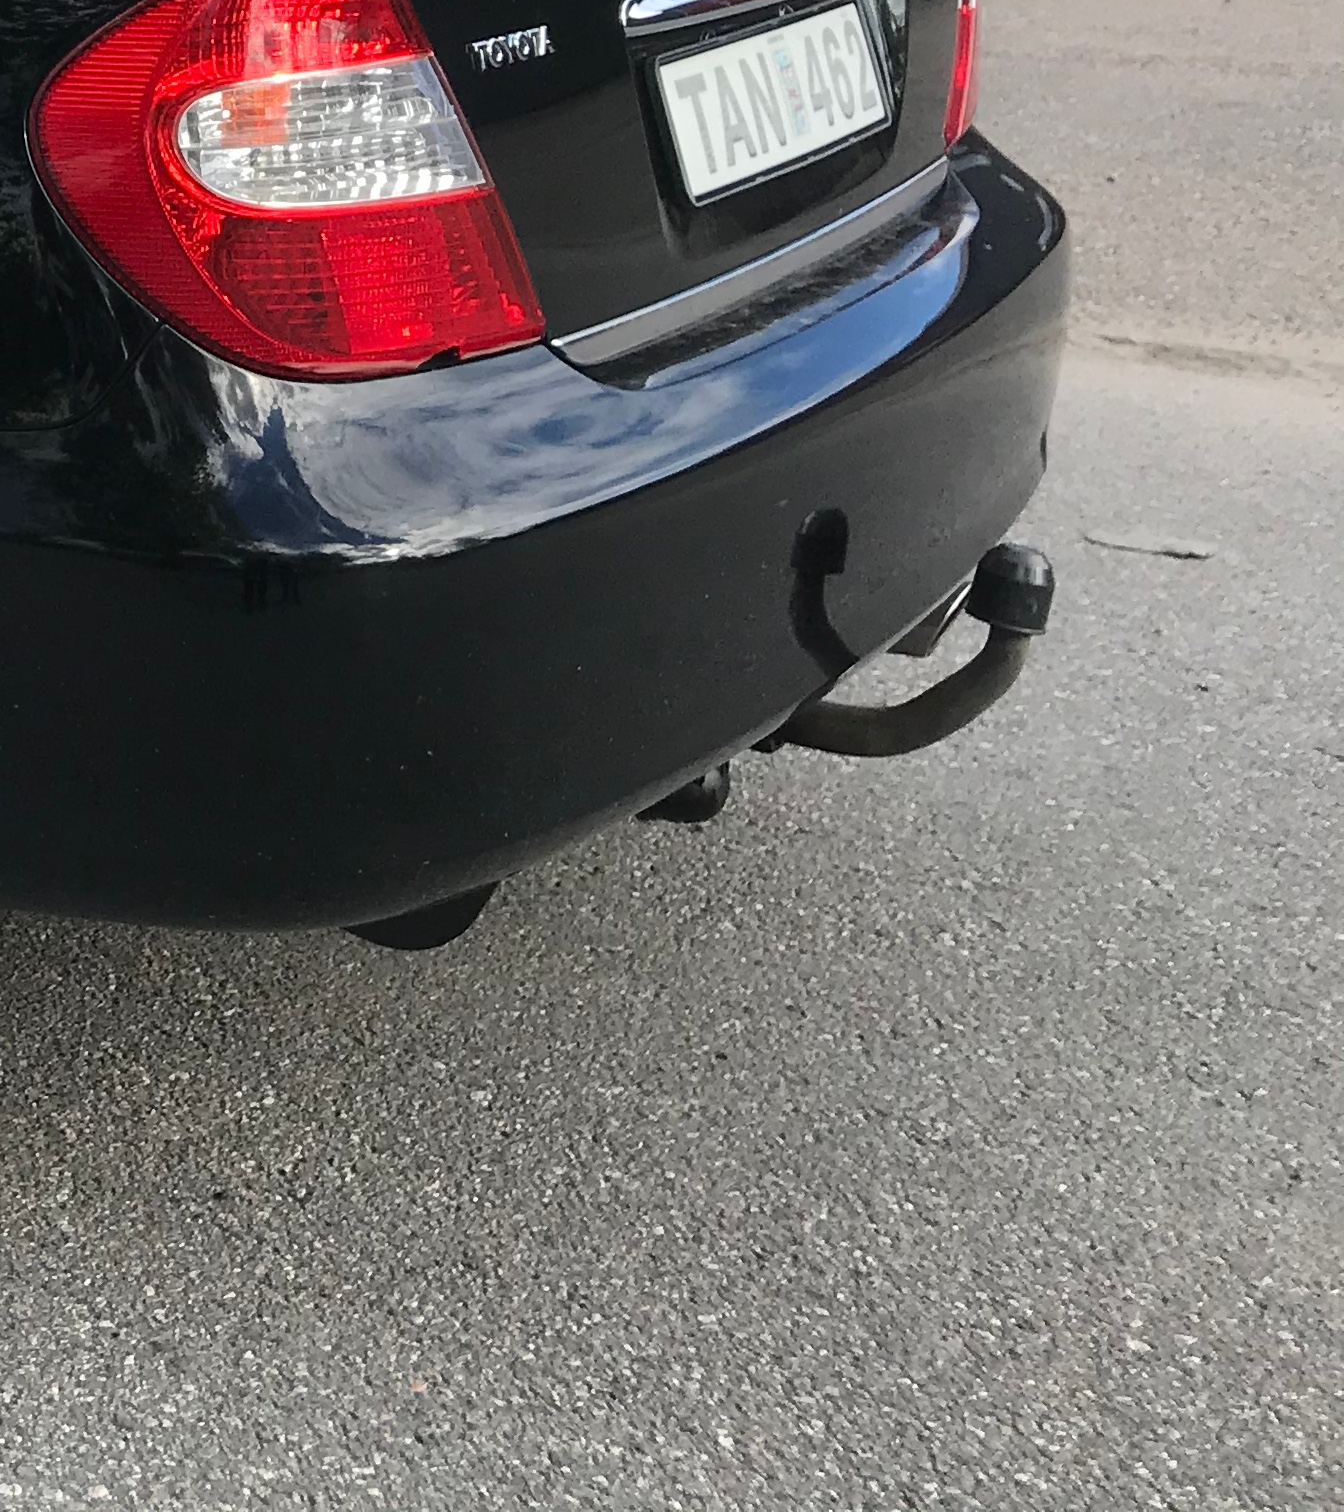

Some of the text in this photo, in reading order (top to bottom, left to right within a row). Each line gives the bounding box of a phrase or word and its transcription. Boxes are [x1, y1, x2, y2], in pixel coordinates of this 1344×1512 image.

[465, 24, 556, 72] TOYOTA
[674, 18, 878, 176] TAN 462
